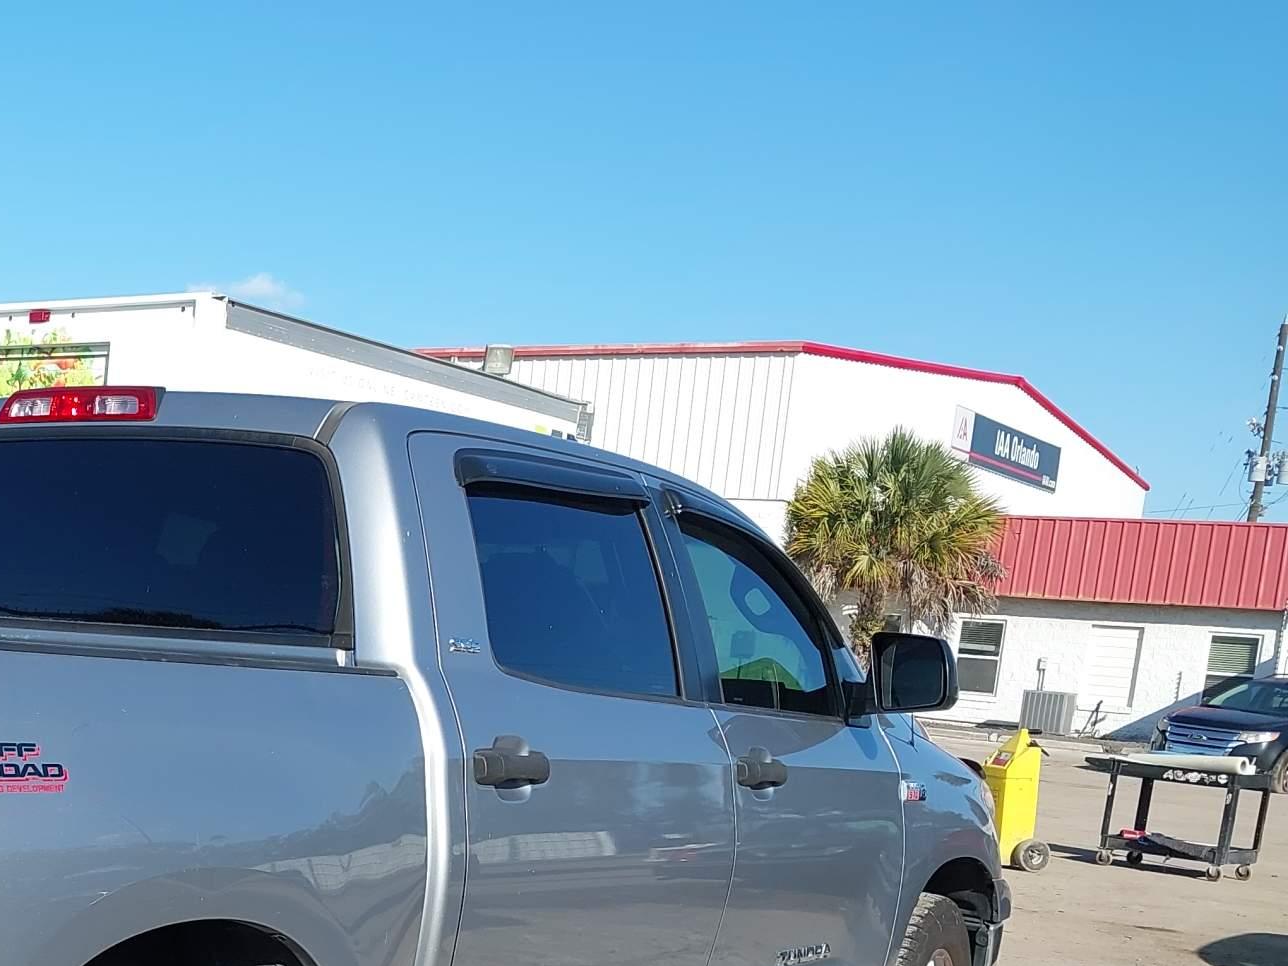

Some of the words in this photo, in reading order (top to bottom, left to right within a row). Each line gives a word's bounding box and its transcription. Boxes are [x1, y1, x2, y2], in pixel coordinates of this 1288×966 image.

[995, 430, 1010, 459] IAA
[1011, 436, 1040, 470] Orlando
[5, 784, 64, 793] DEVELOPMENT
